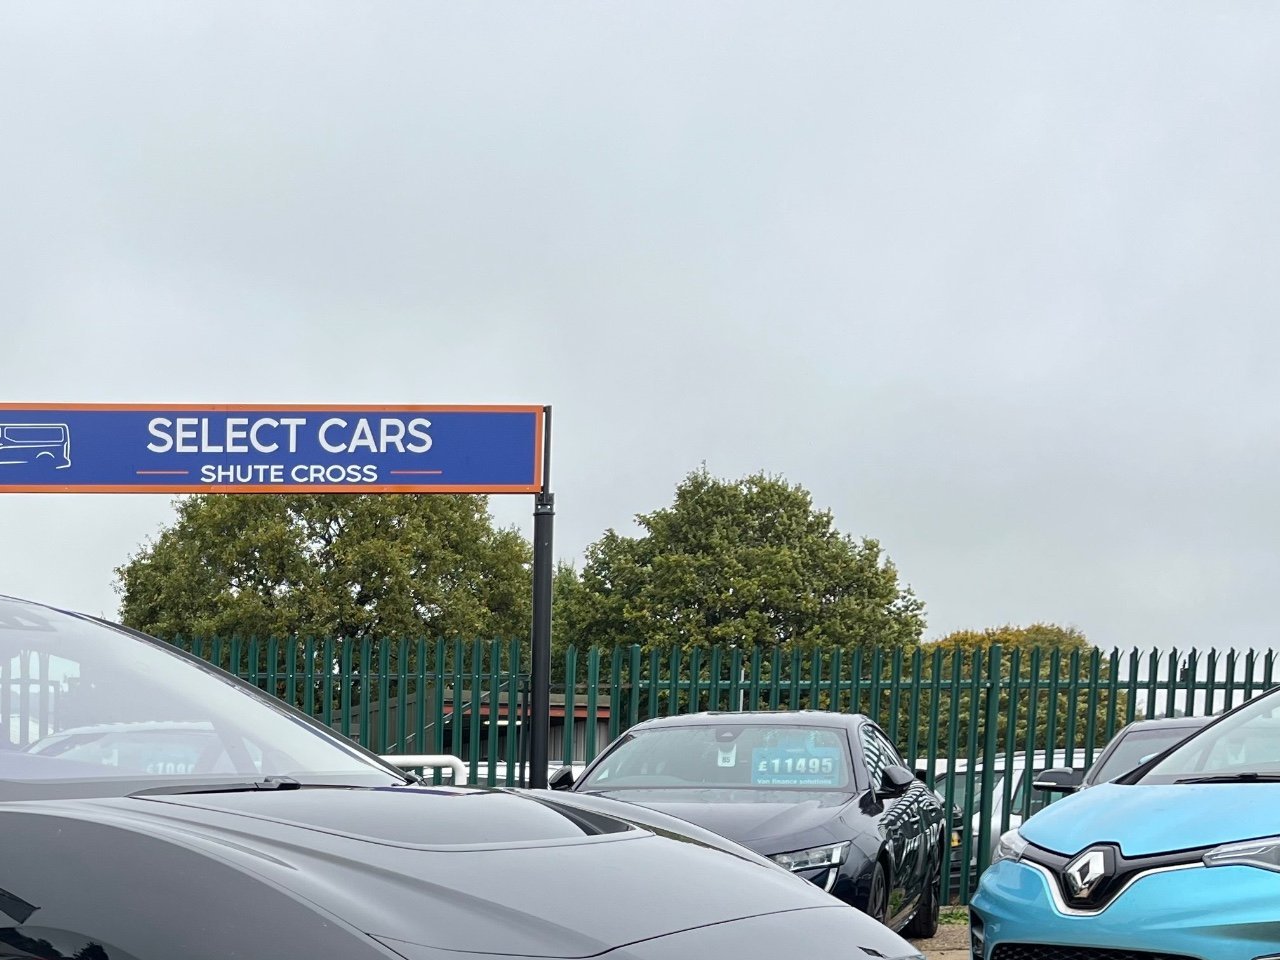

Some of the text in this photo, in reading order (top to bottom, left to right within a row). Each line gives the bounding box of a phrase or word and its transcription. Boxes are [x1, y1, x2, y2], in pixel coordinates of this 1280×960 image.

[146, 417, 433, 454] SELECT CARS
[200, 463, 379, 484] SHUTE CROSS
